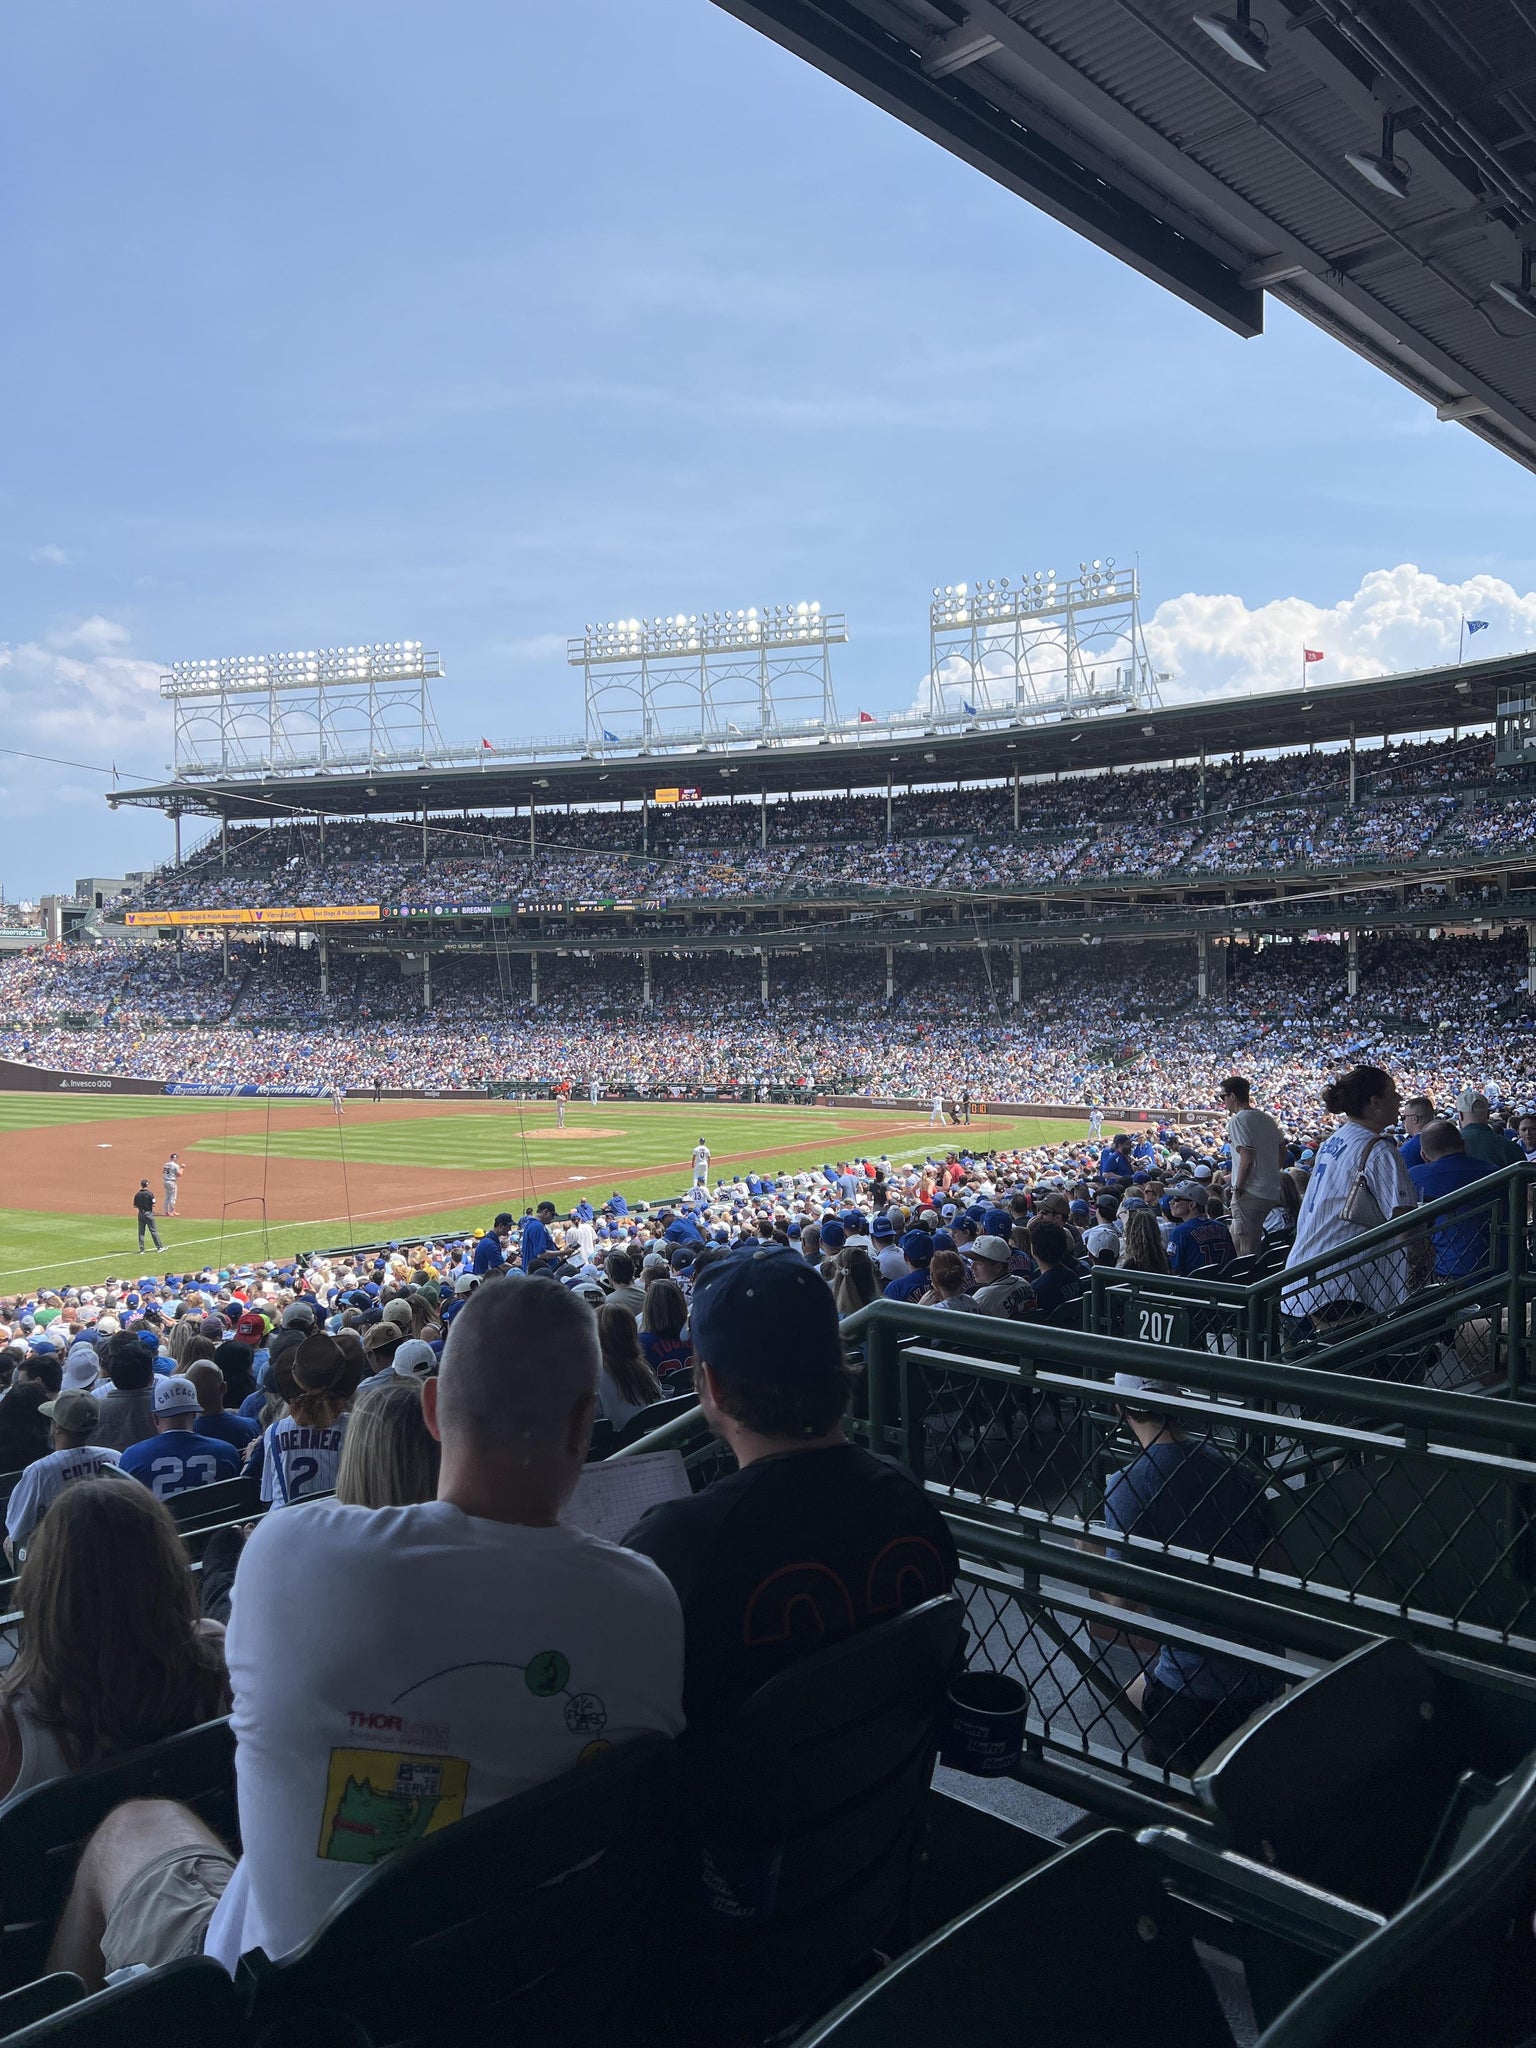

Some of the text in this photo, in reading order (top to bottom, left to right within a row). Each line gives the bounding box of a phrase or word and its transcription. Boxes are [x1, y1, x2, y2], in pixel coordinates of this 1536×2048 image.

[461, 906, 491, 914] BREGMAN
[645, 901, 656, 910] 77
[70, 1079, 112, 1088] Invesco QQQ
[173, 1085, 231, 1097] Reynolds Wrap
[255, 1085, 319, 1098] Reynolds Wrap
[1309, 1163, 1327, 1213] 7
[694, 1191, 701, 1201] 13
[1200, 1242, 1231, 1265] 17
[1139, 1310, 1174, 1343] 207
[158, 1387, 196, 1404] CHICAGO
[151, 1454, 217, 1502] 23
[289, 1456, 319, 1500] 2
